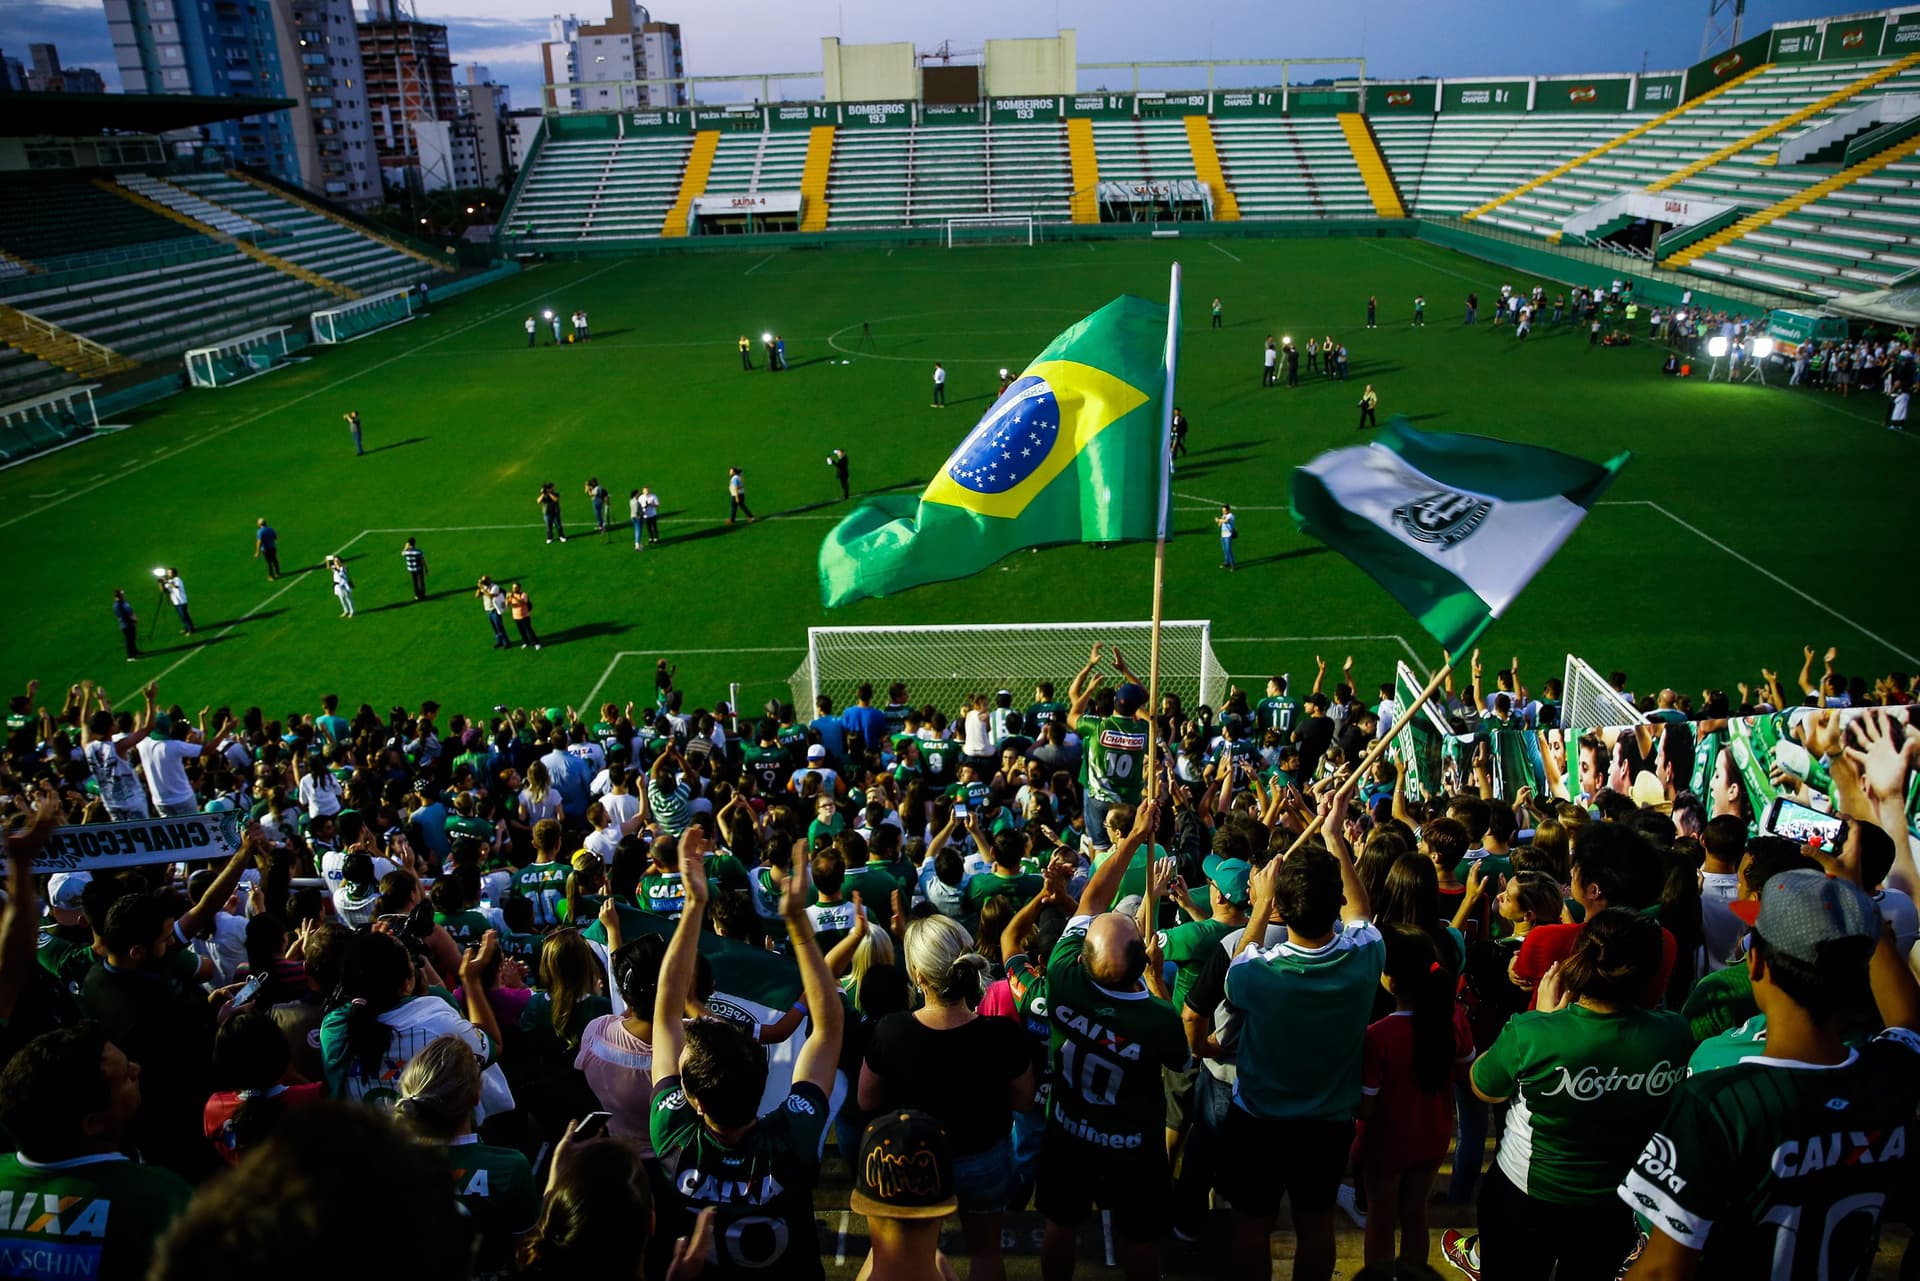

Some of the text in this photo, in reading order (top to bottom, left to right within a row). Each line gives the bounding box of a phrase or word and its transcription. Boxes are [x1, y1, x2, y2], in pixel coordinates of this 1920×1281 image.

[848, 104, 905, 115] BOMBEIROS
[996, 99, 1053, 110] BOMBEIROS
[1188, 96, 1204, 105] 190
[868, 115, 886, 124] 193
[1016, 109, 1034, 119] 193
[1268, 701, 1295, 709] CAIXA
[1272, 709, 1291, 731] 10
[1106, 749, 1134, 778] 10
[763, 770, 776, 789] 9
[520, 870, 564, 884] CAIXA
[1056, 1004, 1143, 1062] CAIXA
[1060, 1037, 1126, 1106] 10
[1541, 1066, 1646, 1101] Nostra
[1771, 1124, 1905, 1180] CAIXA
[676, 1167, 784, 1206] CAIXA
[1757, 1190, 1887, 1281] 10
[20, 1249, 93, 1277] SCHIN
